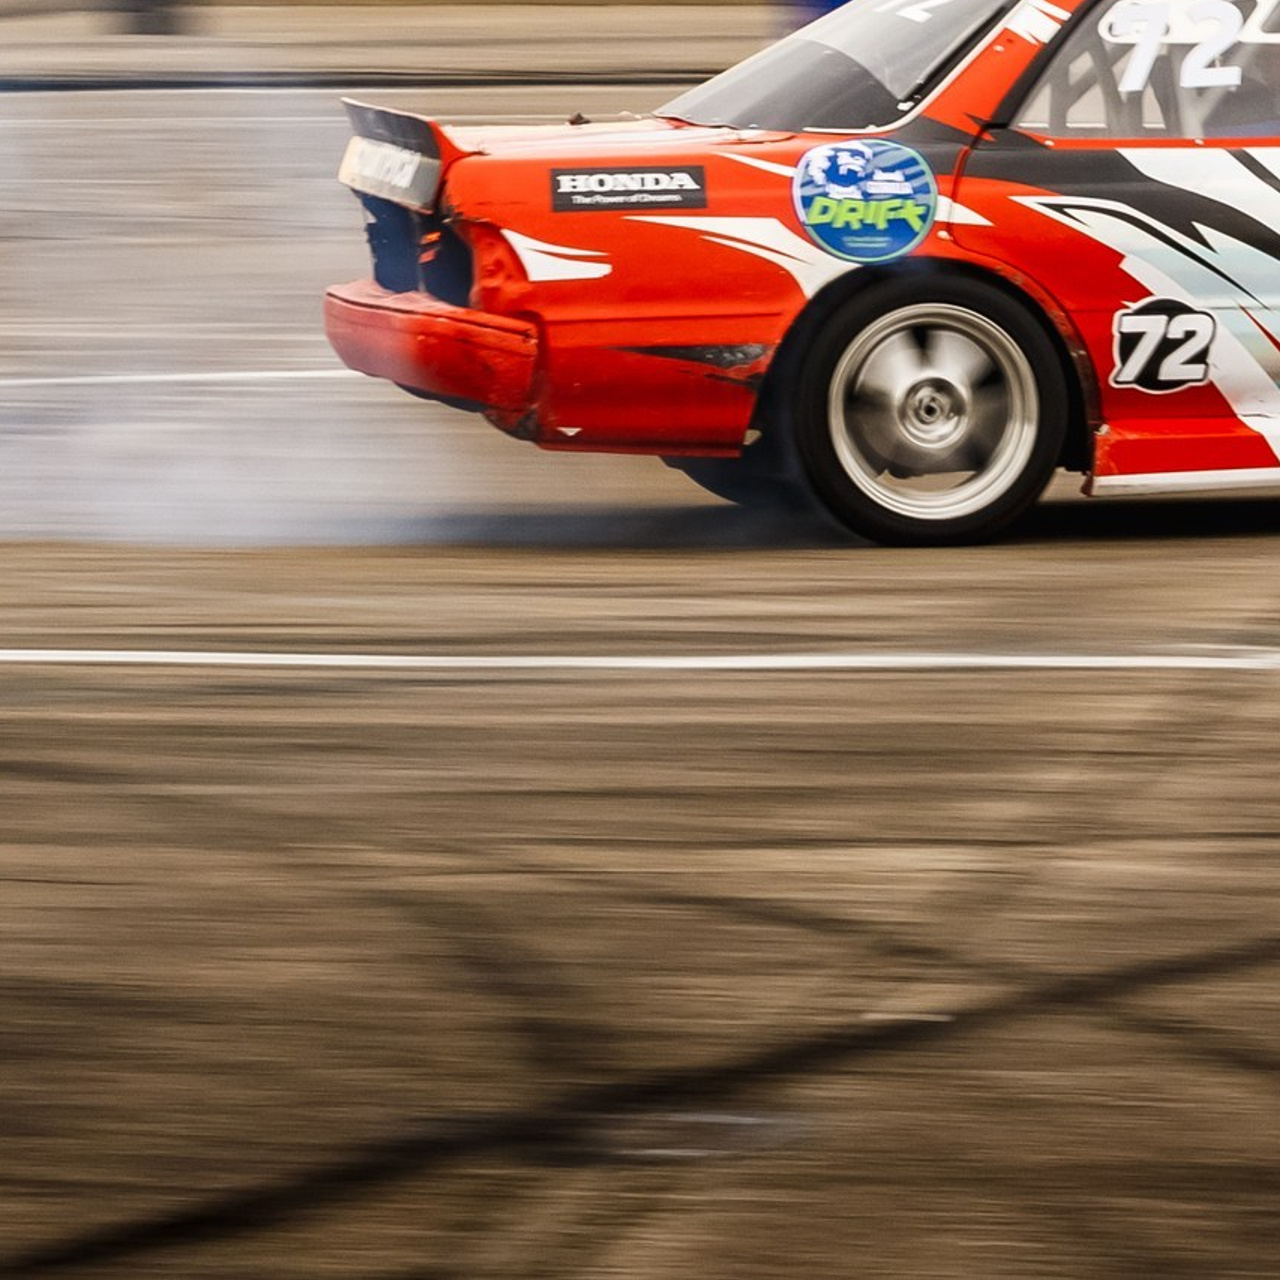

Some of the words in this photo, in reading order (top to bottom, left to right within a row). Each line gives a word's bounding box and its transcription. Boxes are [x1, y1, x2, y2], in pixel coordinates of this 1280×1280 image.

[1110, 0, 1243, 92] 72
[556, 172, 701, 192] HONDA
[1115, 313, 1215, 381] 72
